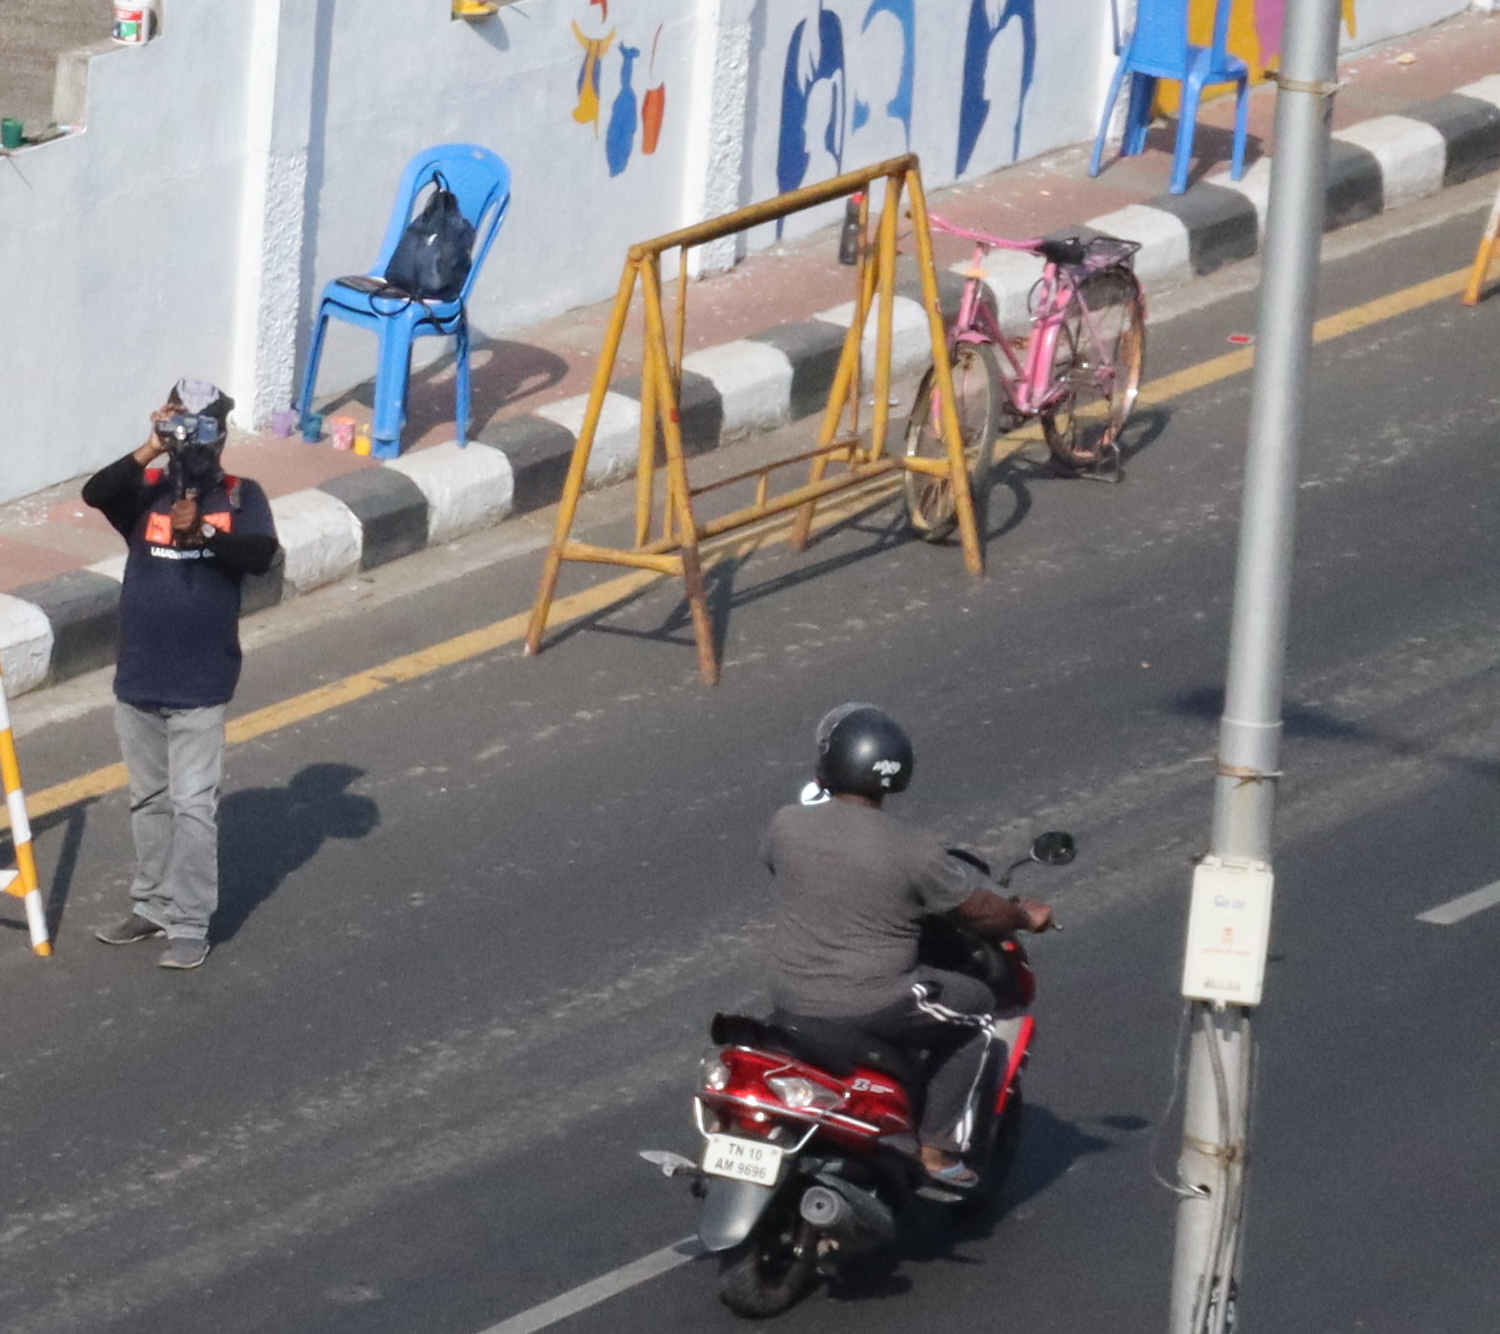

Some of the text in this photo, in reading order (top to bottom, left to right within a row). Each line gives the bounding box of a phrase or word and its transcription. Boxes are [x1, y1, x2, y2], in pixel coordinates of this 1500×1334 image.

[728, 1142, 763, 1160] TN 10
[715, 1158, 767, 1179] AM 9696
